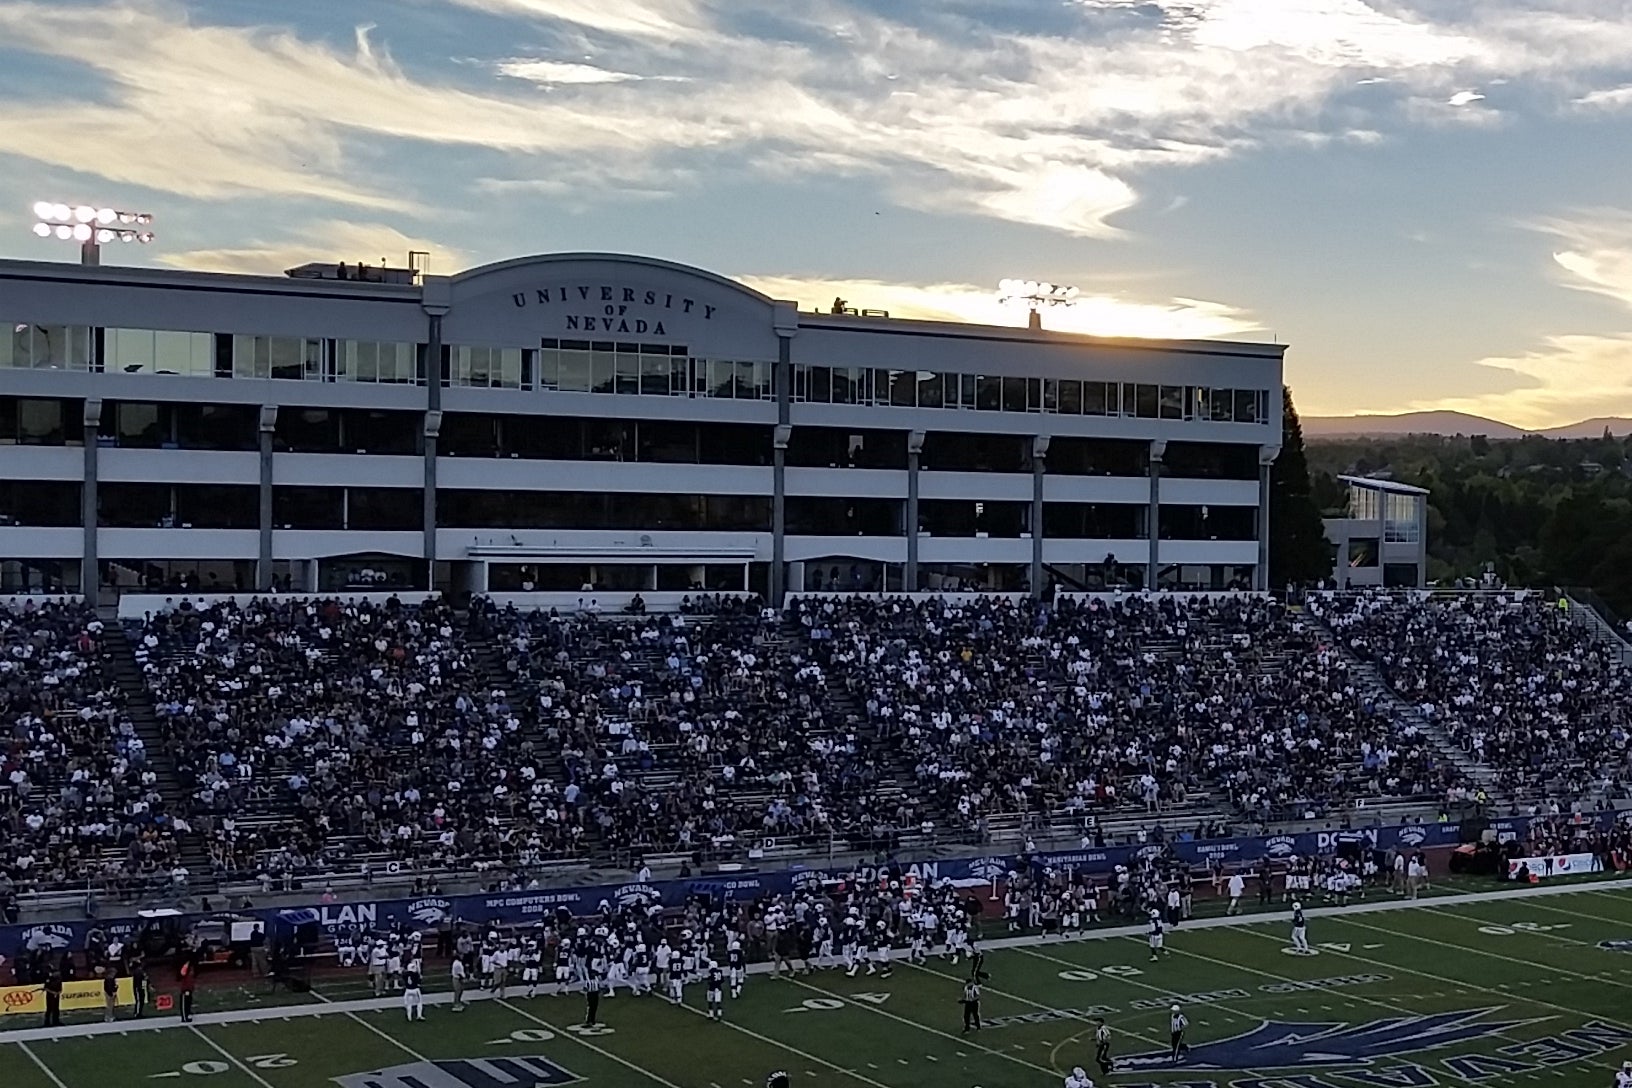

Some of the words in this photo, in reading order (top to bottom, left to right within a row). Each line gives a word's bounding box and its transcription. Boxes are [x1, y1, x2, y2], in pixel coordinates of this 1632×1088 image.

[512, 286, 717, 320] UNIVERSITY
[604, 304, 628, 316] OF
[566, 315, 667, 335] NEVADA
[407, 898, 451, 914] NEVADA
[506, 895, 555, 907] COMPUTERS
[556, 893, 581, 903] BOWL
[1058, 965, 1145, 982] 50
[802, 992, 891, 1010] 40
[182, 1053, 299, 1074] 20
